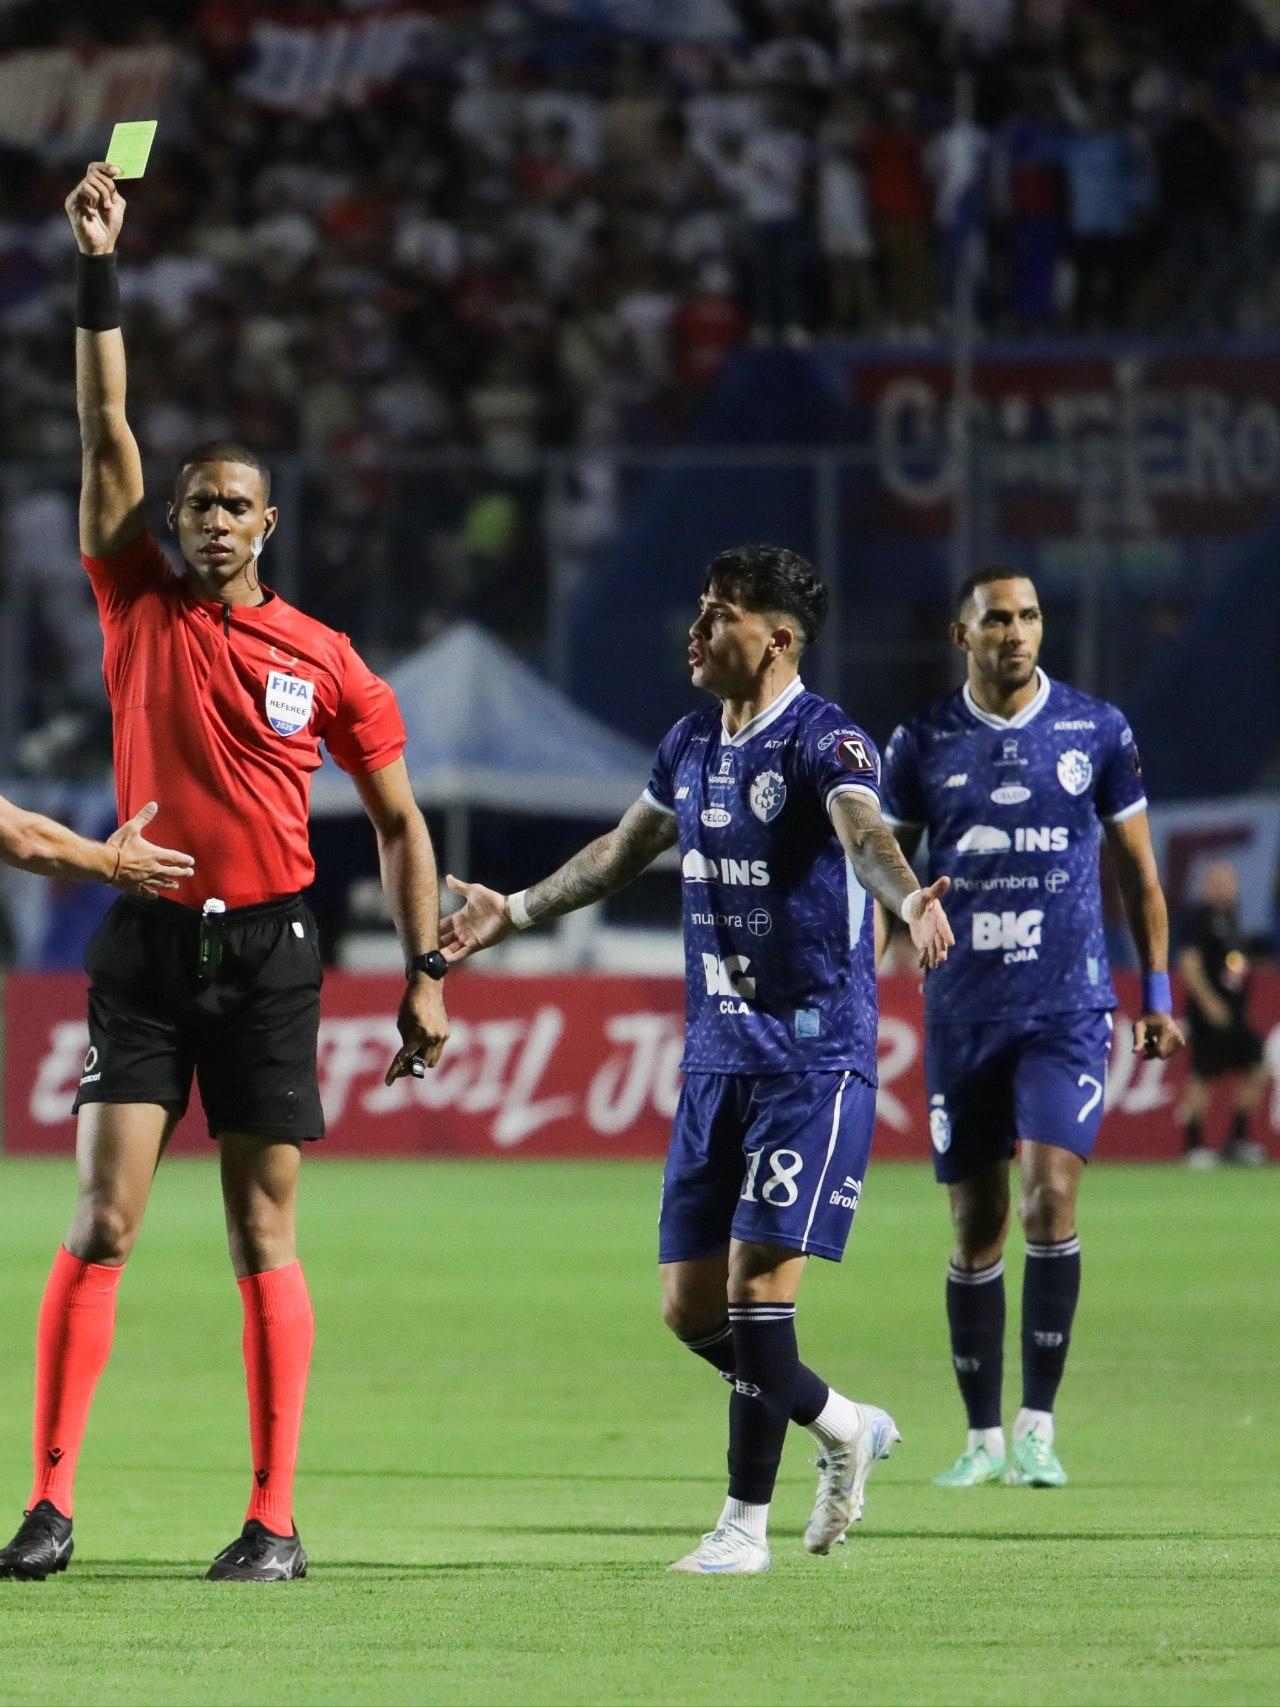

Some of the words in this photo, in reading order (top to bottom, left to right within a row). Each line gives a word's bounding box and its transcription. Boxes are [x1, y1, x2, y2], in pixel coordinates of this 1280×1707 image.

[272, 676, 308, 699] FIFA
[270, 700, 307, 716] REFEREE
[1015, 826, 1069, 852] INS
[720, 858, 771, 887] INS
[972, 909, 1044, 951] BIG
[1077, 1074, 1103, 1123] 7
[740, 1148, 804, 1207] 18
